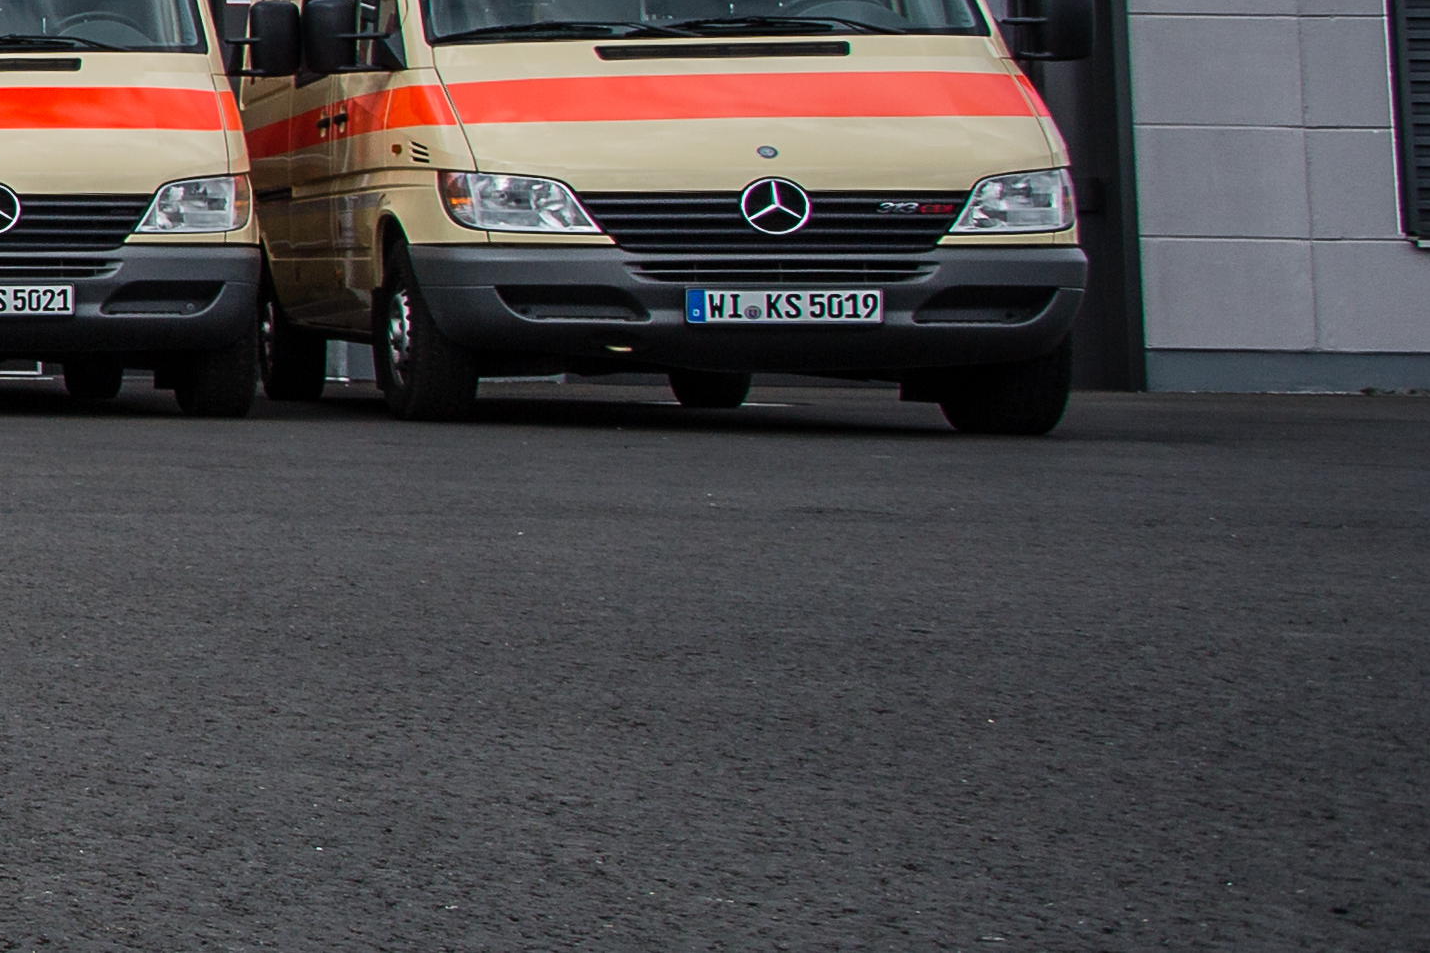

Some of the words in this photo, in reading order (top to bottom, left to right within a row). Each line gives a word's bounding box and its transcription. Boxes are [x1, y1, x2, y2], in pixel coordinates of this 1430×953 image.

[13, 289, 70, 311] 5021
[708, 294, 742, 318] WI
[766, 294, 802, 318] KS
[809, 294, 878, 318] 5019
